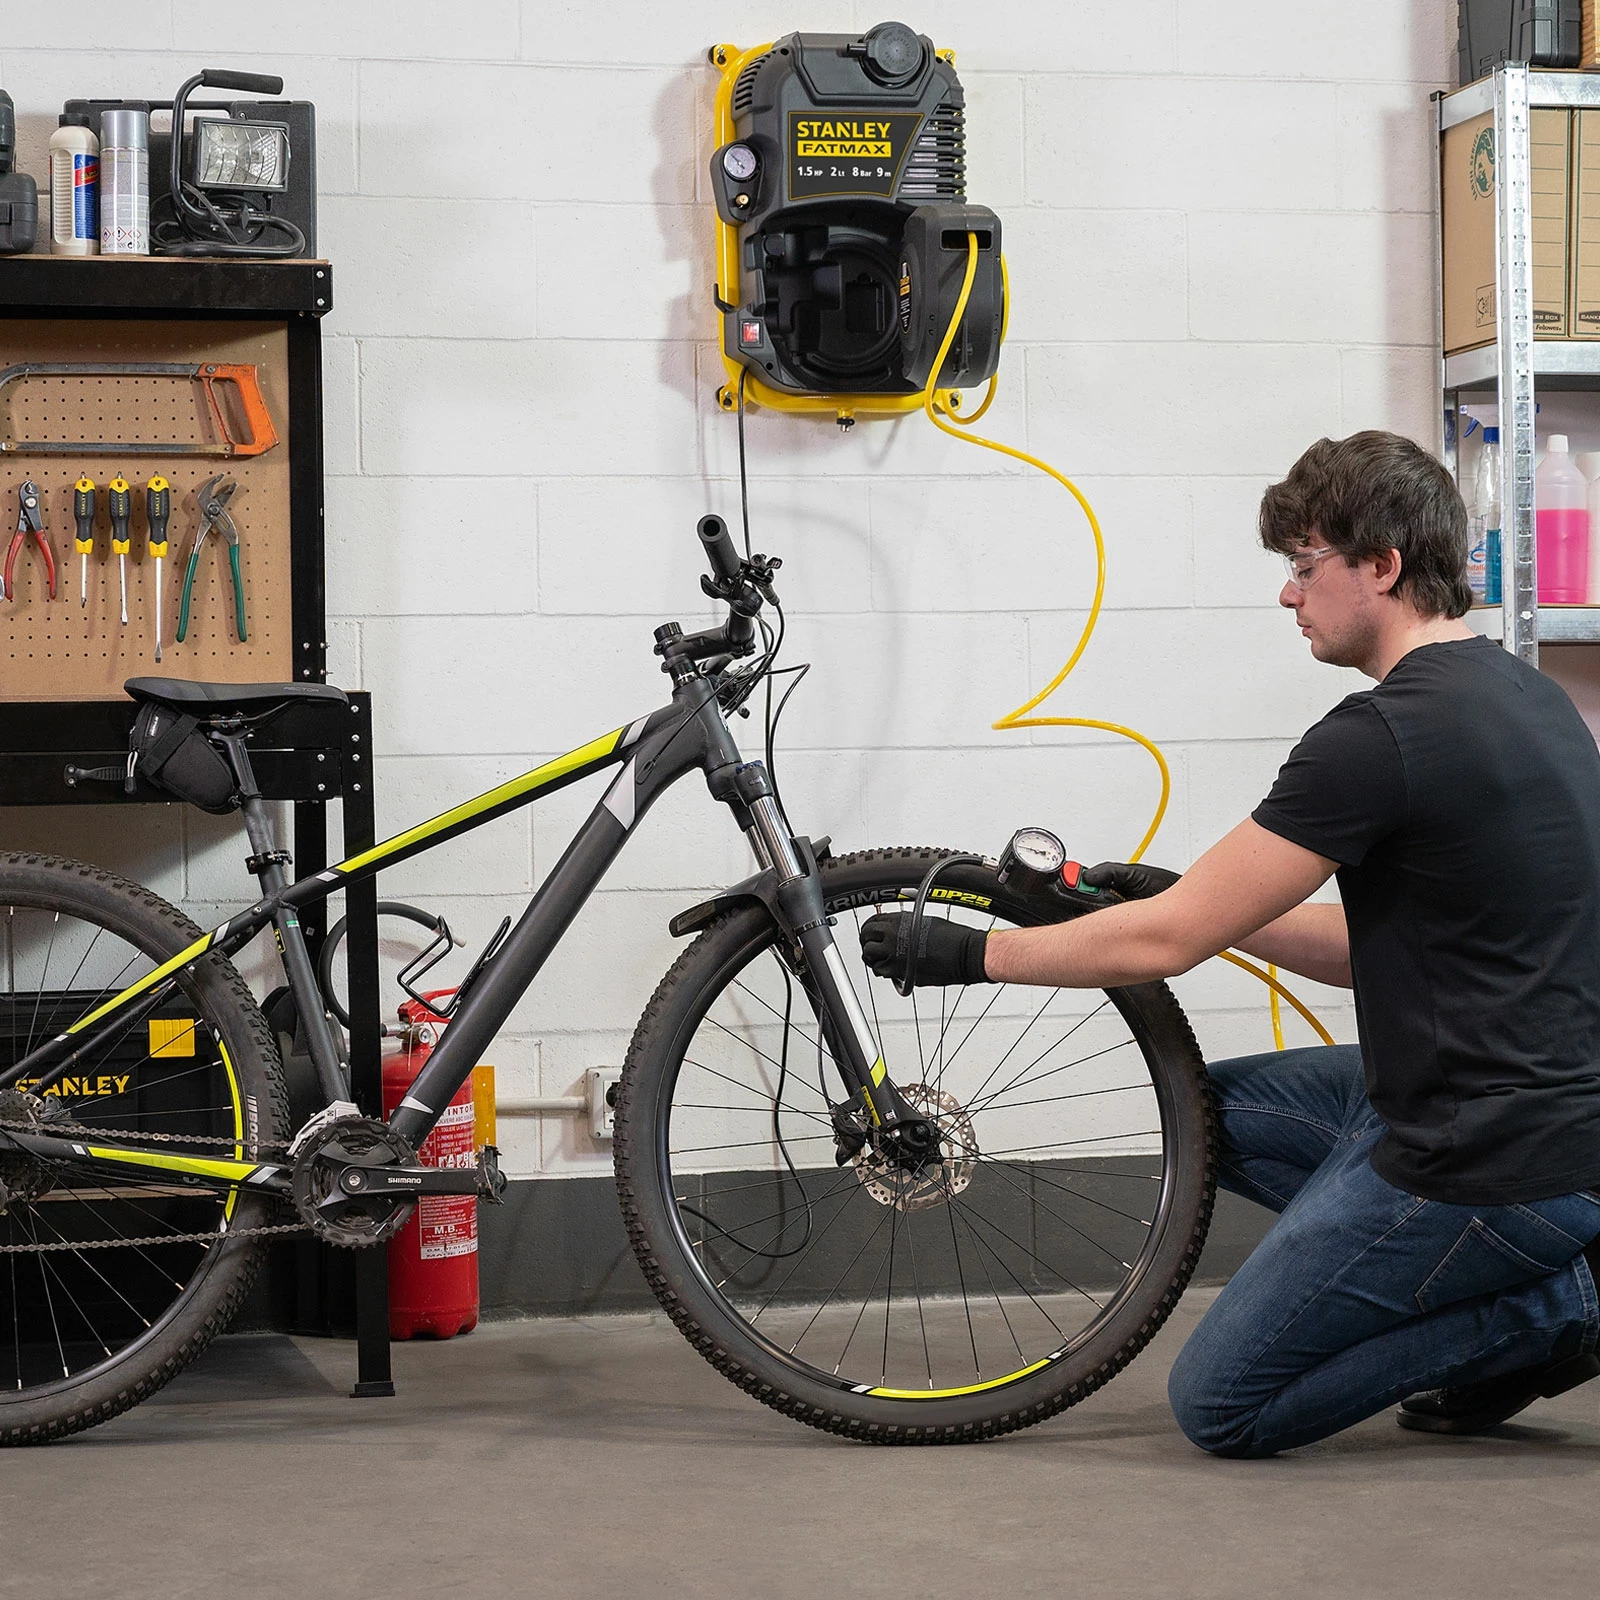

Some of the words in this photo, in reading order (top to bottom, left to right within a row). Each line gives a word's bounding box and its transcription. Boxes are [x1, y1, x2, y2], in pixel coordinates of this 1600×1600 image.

[797, 121, 891, 138] STANLEY
[803, 143, 886, 155] FATMAX
[797, 166, 813, 176] 1.5
[830, 166, 837, 176] 2
[852, 166, 859, 177] 8
[876, 167, 883, 177] 9
[931, 888, 992, 907] DP25
